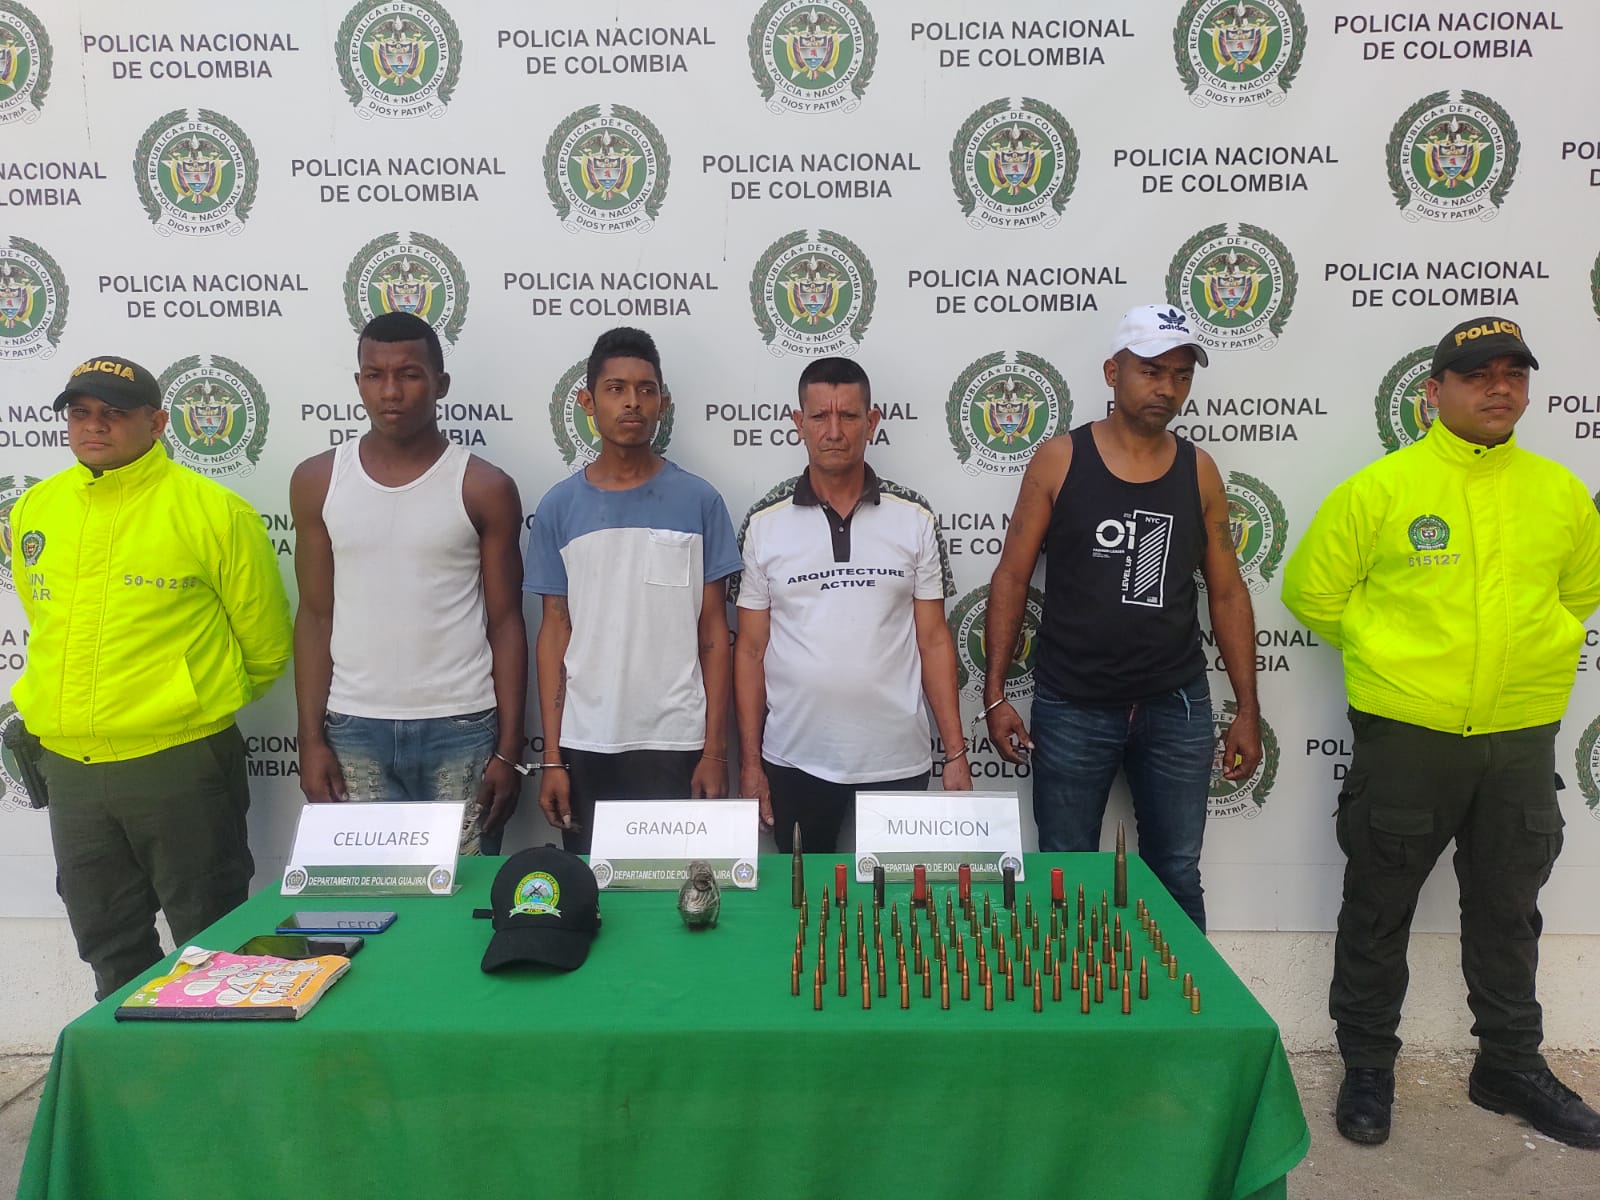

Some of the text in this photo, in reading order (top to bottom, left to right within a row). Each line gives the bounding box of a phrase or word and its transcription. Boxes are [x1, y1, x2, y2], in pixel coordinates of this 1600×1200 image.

[912, 19, 1134, 40] POLICIA NACIONAL
[1335, 12, 1563, 34] POLICIA NACIONAL
[84, 34, 299, 53] POLICIA NACIONAL
[498, 27, 715, 48] POLICIA NACIONAL
[940, 47, 1105, 67] DE COLOMBIA
[1364, 39, 1533, 60] DE COLOMBIA
[113, 61, 272, 79] DE COLOMBIA
[527, 55, 688, 74] DE COLOMBIA
[401, 73, 443, 103] NACIONAL
[401, 102, 433, 116] PATRIA
[966, 118, 1000, 171] REPUBLICA
[1034, 118, 1064, 170] COLOMBIA
[1402, 111, 1439, 164] REPUBLICA
[1474, 110, 1503, 163] COLOMBIA
[149, 128, 179, 180] REPUBLICA
[212, 128, 244, 179] COLOMBIA
[559, 124, 591, 176] REPUBLICA
[625, 124, 655, 176] COLOMBIA
[1114, 146, 1338, 167] POLICIA NACIONAL
[292, 158, 506, 176] POLICIA NACIONAL
[703, 153, 920, 173] POLICIA NACIONAL
[732, 180, 892, 199] DE COLOMBIA
[1143, 173, 1308, 193] DE COLOMBIA
[1407, 175, 1498, 206] POLICIA NACIONAL
[321, 184, 478, 202] DE COLOMBIA
[971, 182, 1059, 213] POLICIA NACIONAL
[156, 191, 240, 221] POLICIA NACIONAL
[565, 188, 651, 218] POLICIA NACIONAL
[1417, 204, 1440, 218] DIOS
[1450, 204, 1485, 219] PATRIA
[168, 219, 190, 232] DIOS
[199, 219, 231, 233] PATRIA
[576, 216, 599, 229] DIOS
[608, 217, 641, 230] PATRIA
[981, 211, 1004, 225] DIOS
[1014, 212, 1047, 226] PATRIA
[766, 249, 798, 301] REPUBLICA
[831, 250, 861, 300] COLOMBIA
[909, 267, 1127, 288] POLICIA NACIONAL
[1182, 243, 1217, 295] REPUBLICA
[1252, 243, 1281, 293] COLOMBIA
[1325, 261, 1549, 281] POLICIA NACIONAL
[99, 274, 308, 293] POLICIA NACIONAL
[504, 273, 718, 290] POLICIA NACIONAL
[937, 294, 1098, 313] DE COLOMBIA
[1352, 288, 1519, 307] DE COLOMBIA
[128, 300, 282, 318] DE COLOMBIA
[533, 299, 691, 316] DE COLOMBIA
[771, 312, 856, 342] POLICIA NACIONAL
[1187, 306, 1276, 336] POLICIA NACIONAL
[782, 340, 804, 353] DIOS
[813, 340, 846, 354] PATRIA
[1197, 334, 1220, 347] DIOS
[1230, 334, 1264, 348] PATRIA
[224, 374, 255, 423] COLOMBIA
[962, 371, 1057, 421] REPUBLICA COLOMBIA
[301, 404, 366, 421] POLIC
[1207, 398, 1328, 416] NACIONAL
[733, 429, 762, 446] DE
[1174, 424, 1298, 442] COLOMBIA
[169, 434, 251, 463] POLICIA NACIONAL
[966, 433, 997, 459] POLICIA
[211, 461, 242, 474] PATRIA
[939, 513, 995, 530] LICIA
[1145, 516, 1160, 524] NYC
[787, 568, 905, 585] ARQUITECTURE
[1121, 555, 1132, 591] LEVEL UP
[820, 579, 876, 590] ACTIVE
[1216, 777, 1259, 805] NACIONAL
[1215, 804, 1247, 816] PATRIA
[626, 821, 708, 836] GRANADA
[887, 819, 989, 837] MUNICION
[333, 831, 430, 847] CELULARES
[308, 876, 427, 886] DEPARTAMENTO DE POLICIA GUAJIRA
[614, 870, 665, 880] DEPARTAMENTO
[666, 870, 675, 880] DE
